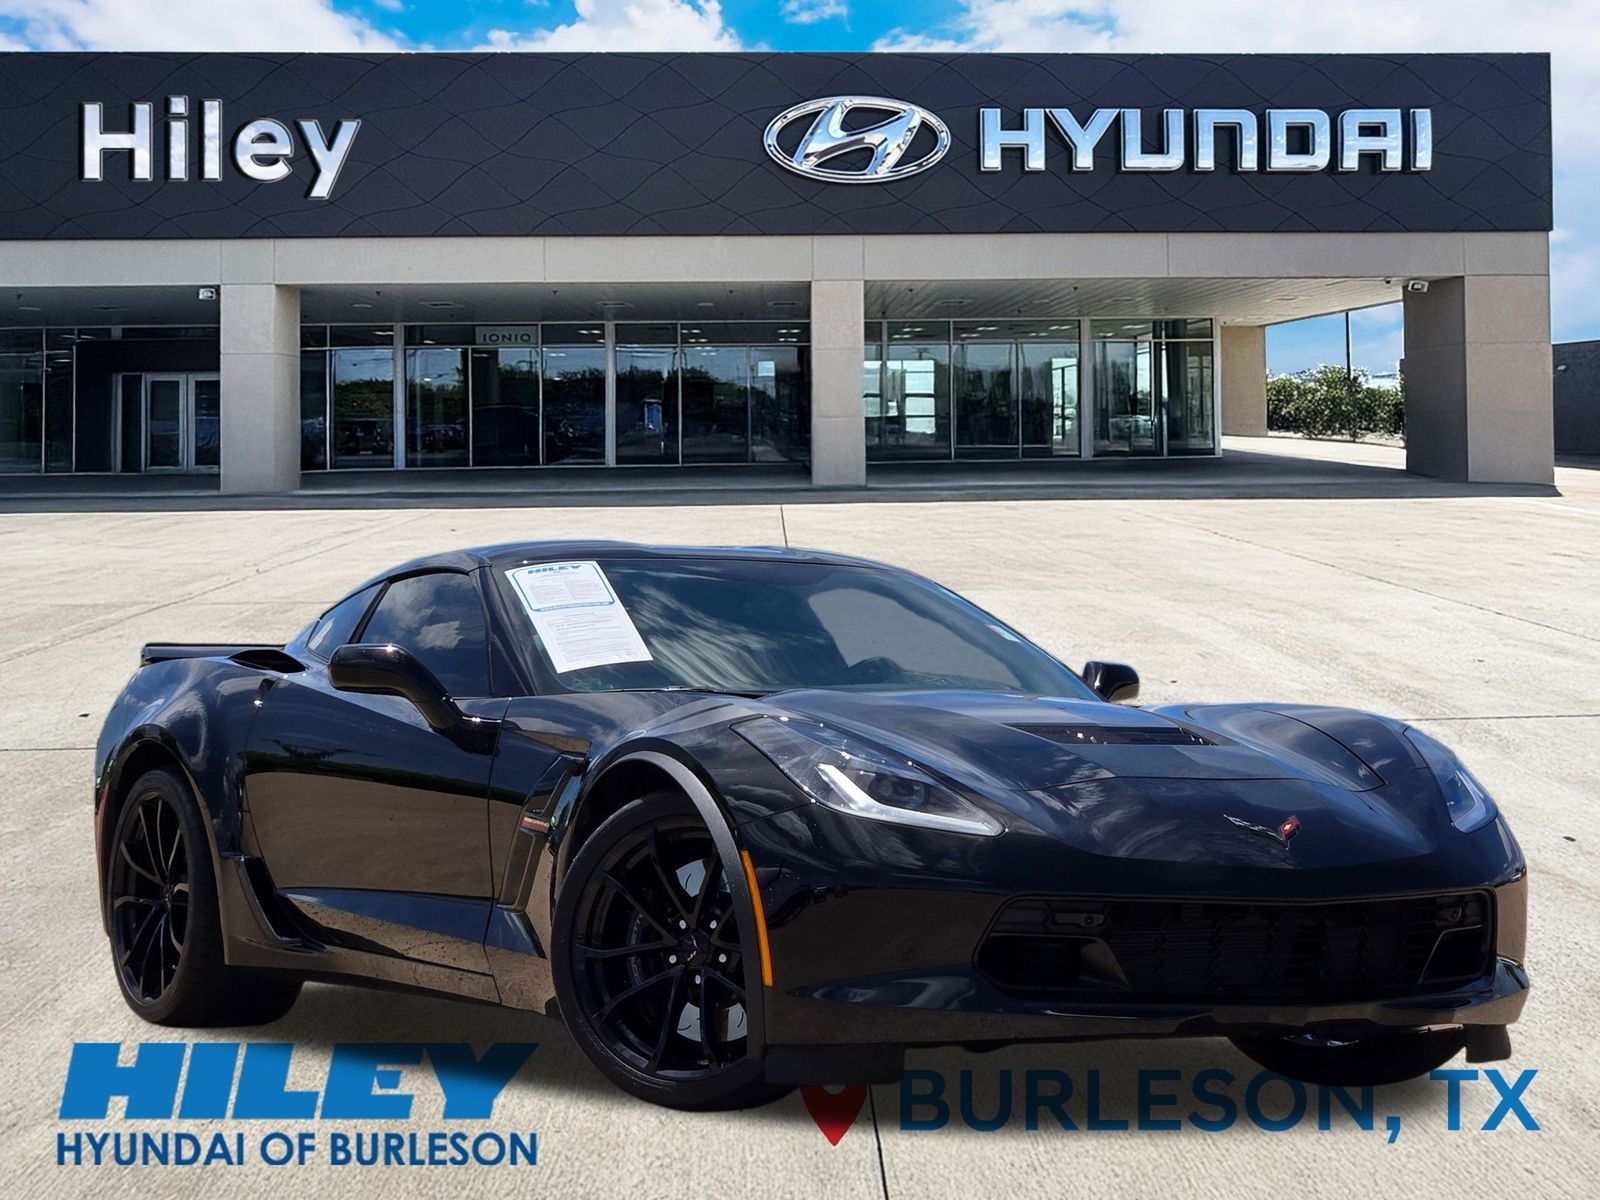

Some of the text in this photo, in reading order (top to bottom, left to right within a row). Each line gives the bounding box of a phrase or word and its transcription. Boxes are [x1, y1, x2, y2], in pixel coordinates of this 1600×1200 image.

[80, 95, 362, 199] Hiley
[979, 107, 1433, 172] HYUNDAI
[483, 333, 531, 343] IONIQ
